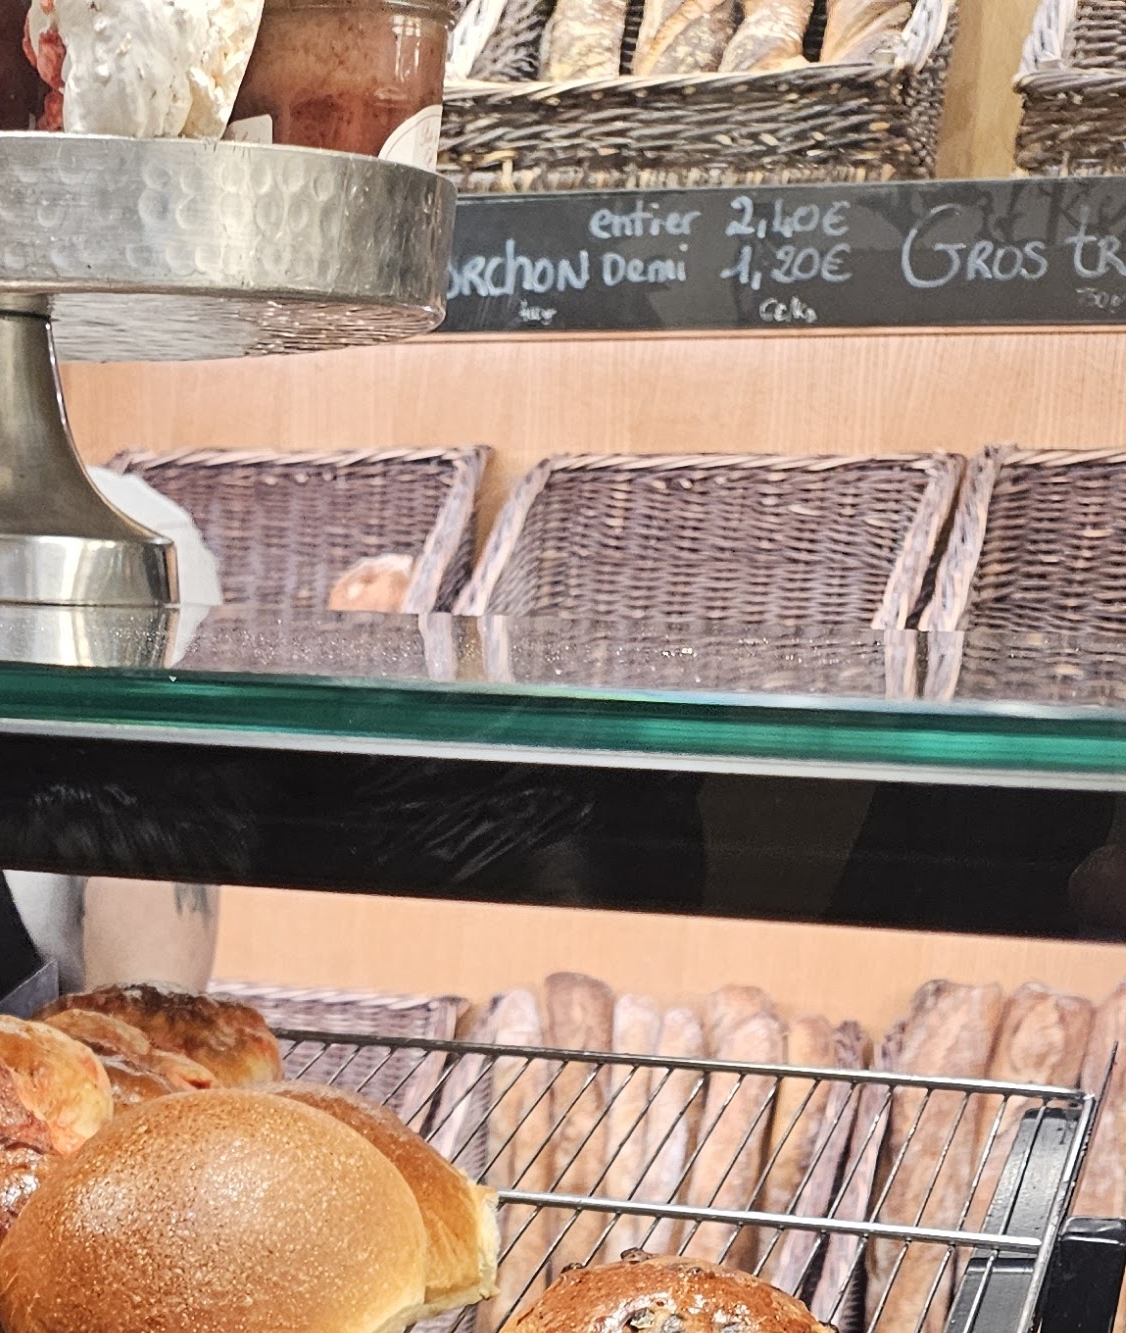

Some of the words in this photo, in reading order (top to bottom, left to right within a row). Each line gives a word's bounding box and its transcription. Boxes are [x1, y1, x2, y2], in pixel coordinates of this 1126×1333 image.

[589, 199, 702, 239] entier
[725, 195, 851, 239] 2,40€
[602, 242, 689, 287] Demi
[720, 243, 853, 291] 1,20€
